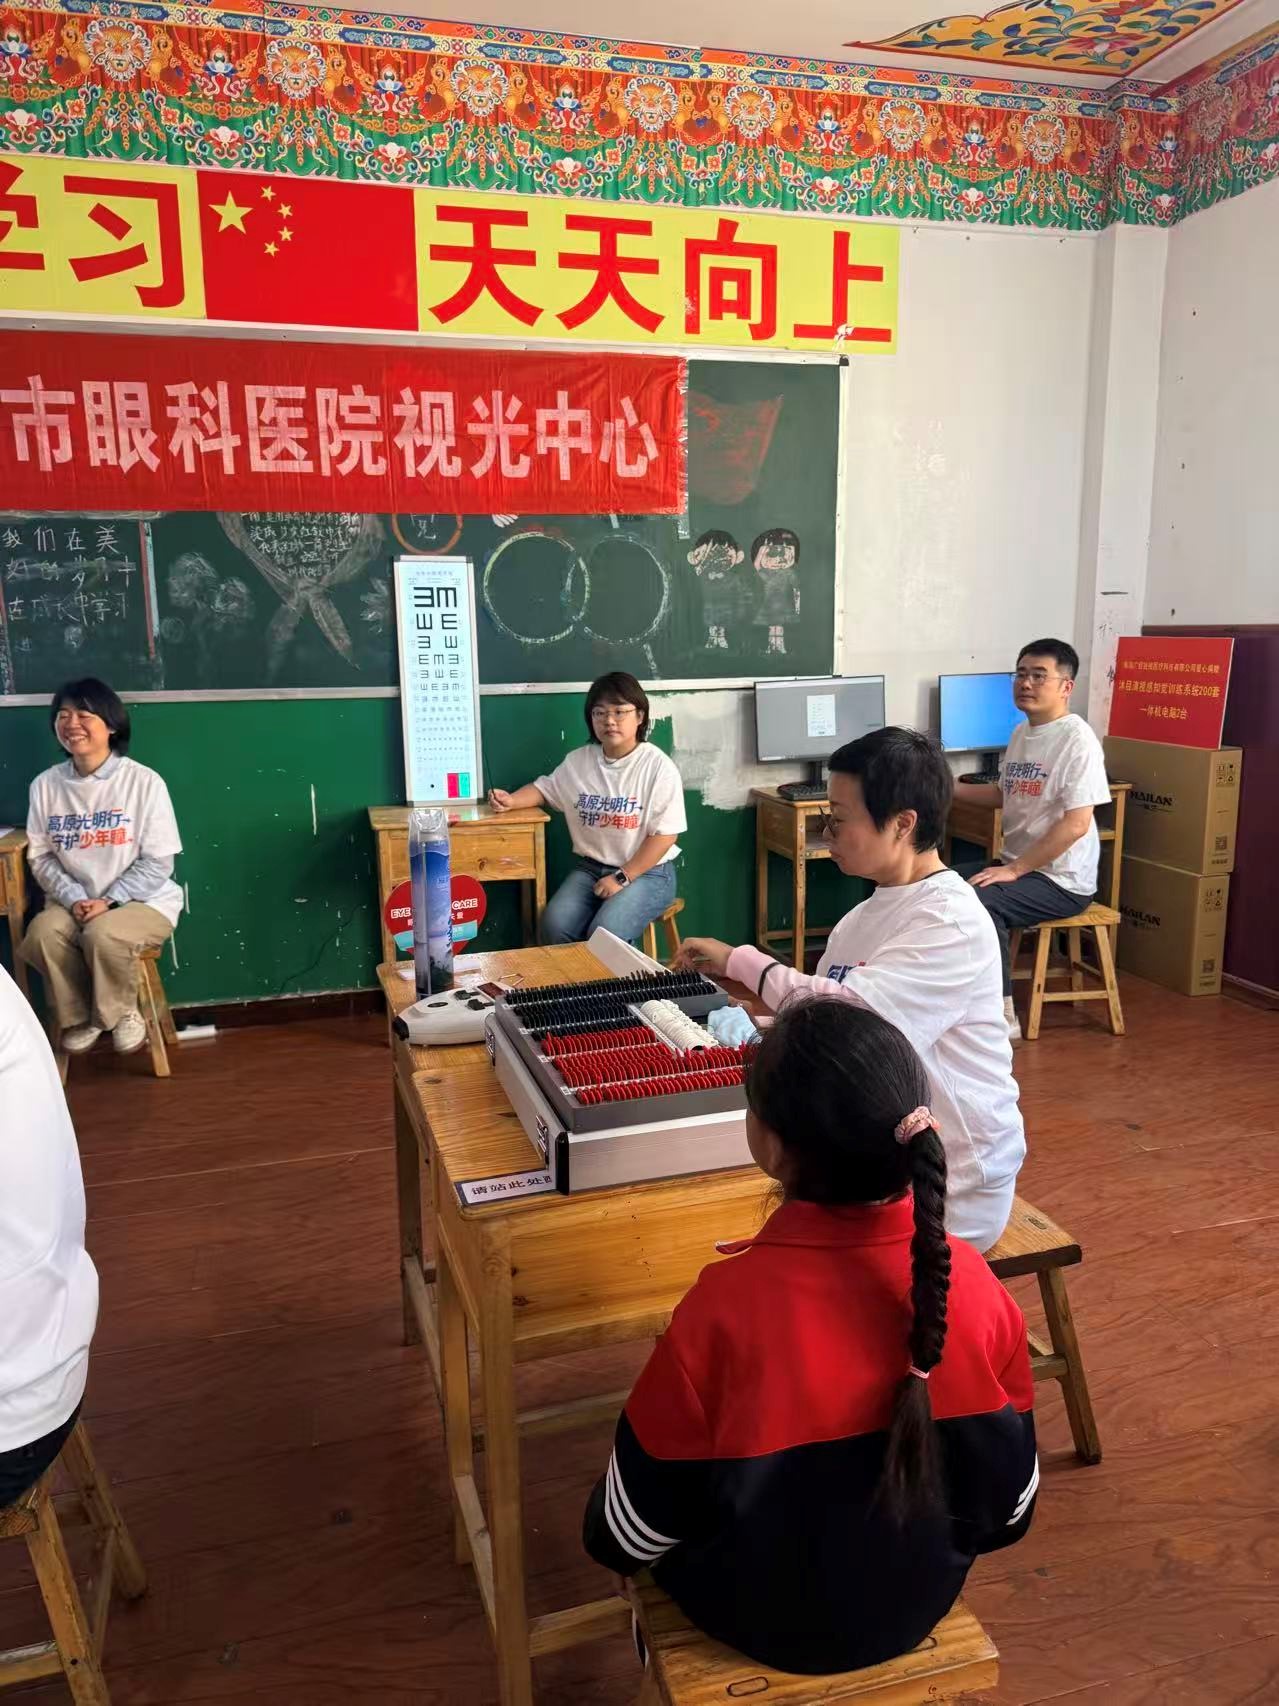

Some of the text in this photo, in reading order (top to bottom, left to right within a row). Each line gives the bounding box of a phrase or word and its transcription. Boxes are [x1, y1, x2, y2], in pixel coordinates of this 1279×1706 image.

[429, 204, 892, 342] 天天向上
[0, 374, 659, 480] 市眼科医院视光中心
[2, 525, 119, 554] 我们在美
[574, 792, 638, 814] 高原光明行
[48, 808, 124, 832] 高原光明行
[51, 828, 128, 852] 守护少年瞳
[391, 898, 478, 919] EYE CARE
